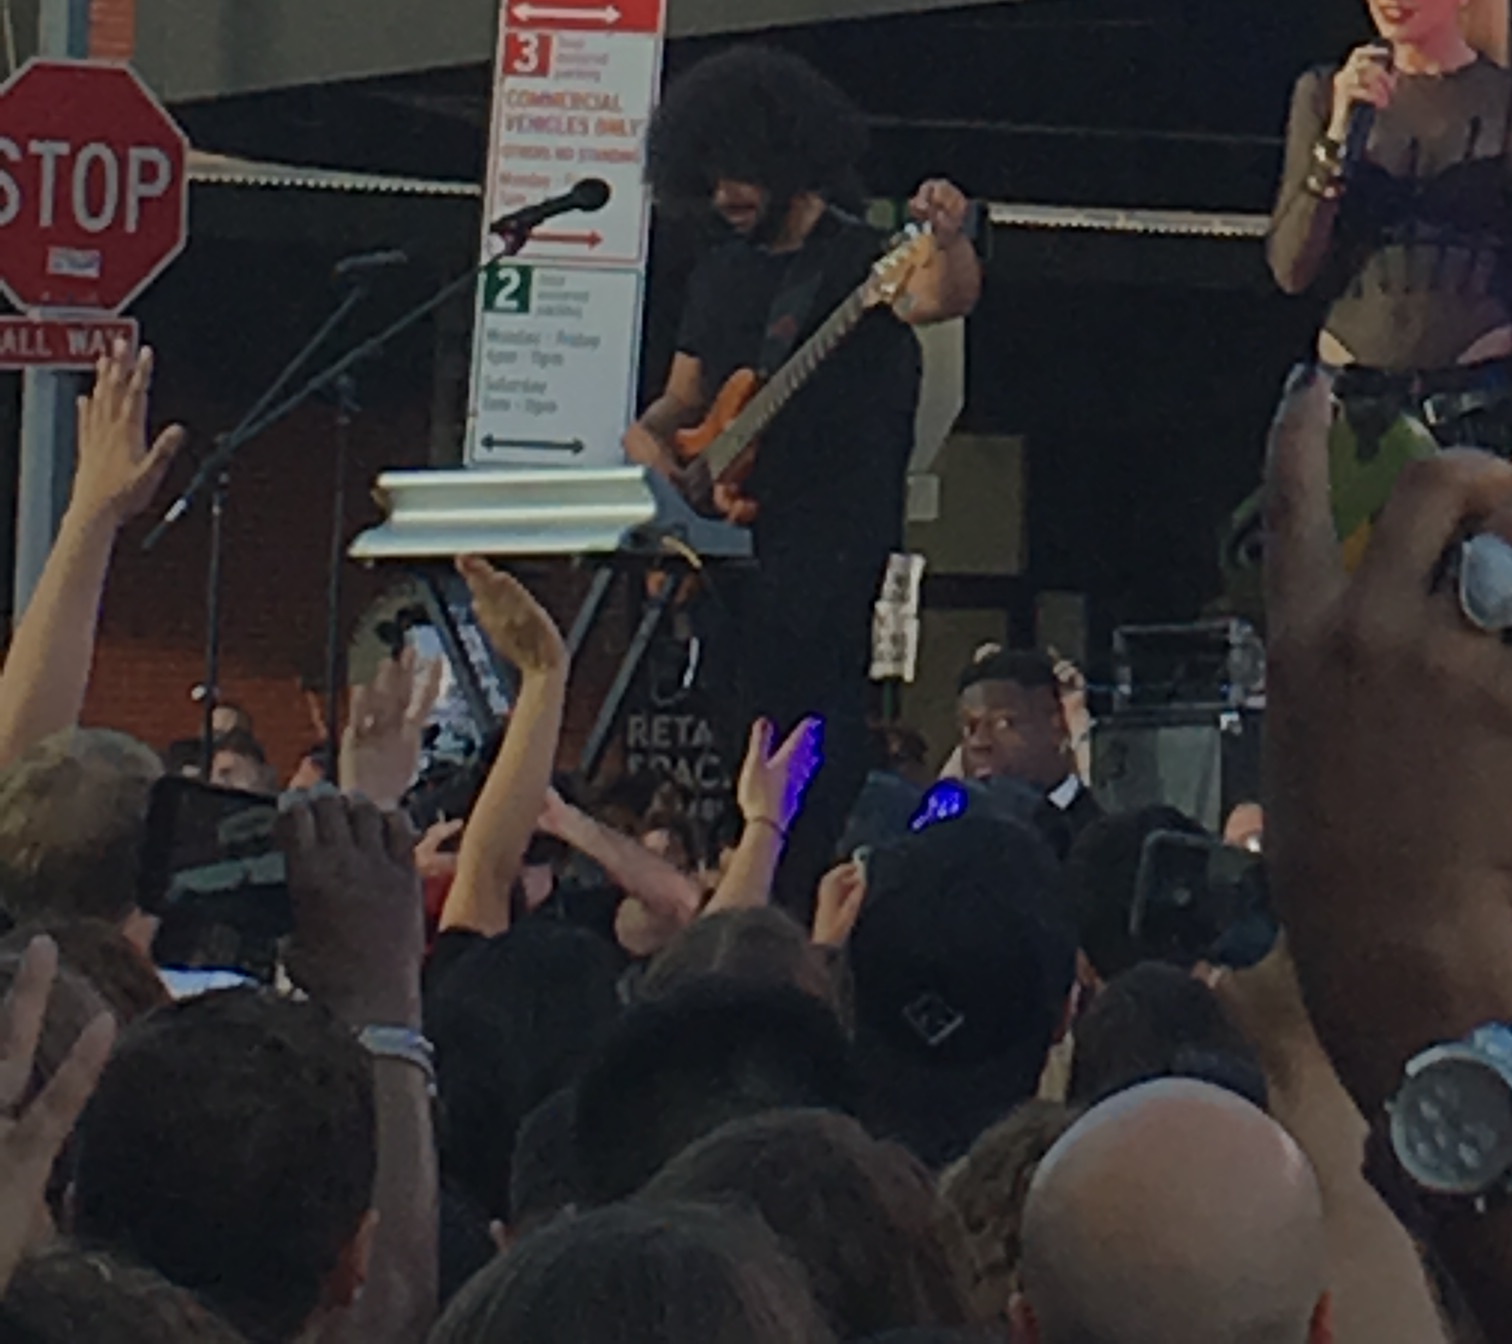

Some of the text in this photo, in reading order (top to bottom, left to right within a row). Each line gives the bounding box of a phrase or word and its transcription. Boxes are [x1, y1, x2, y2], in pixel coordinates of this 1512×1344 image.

[513, 32, 539, 73] 3
[0, 137, 172, 234] STOP
[494, 267, 521, 309] 2
[0, 326, 52, 357] ALL
[626, 713, 713, 748] RETA
